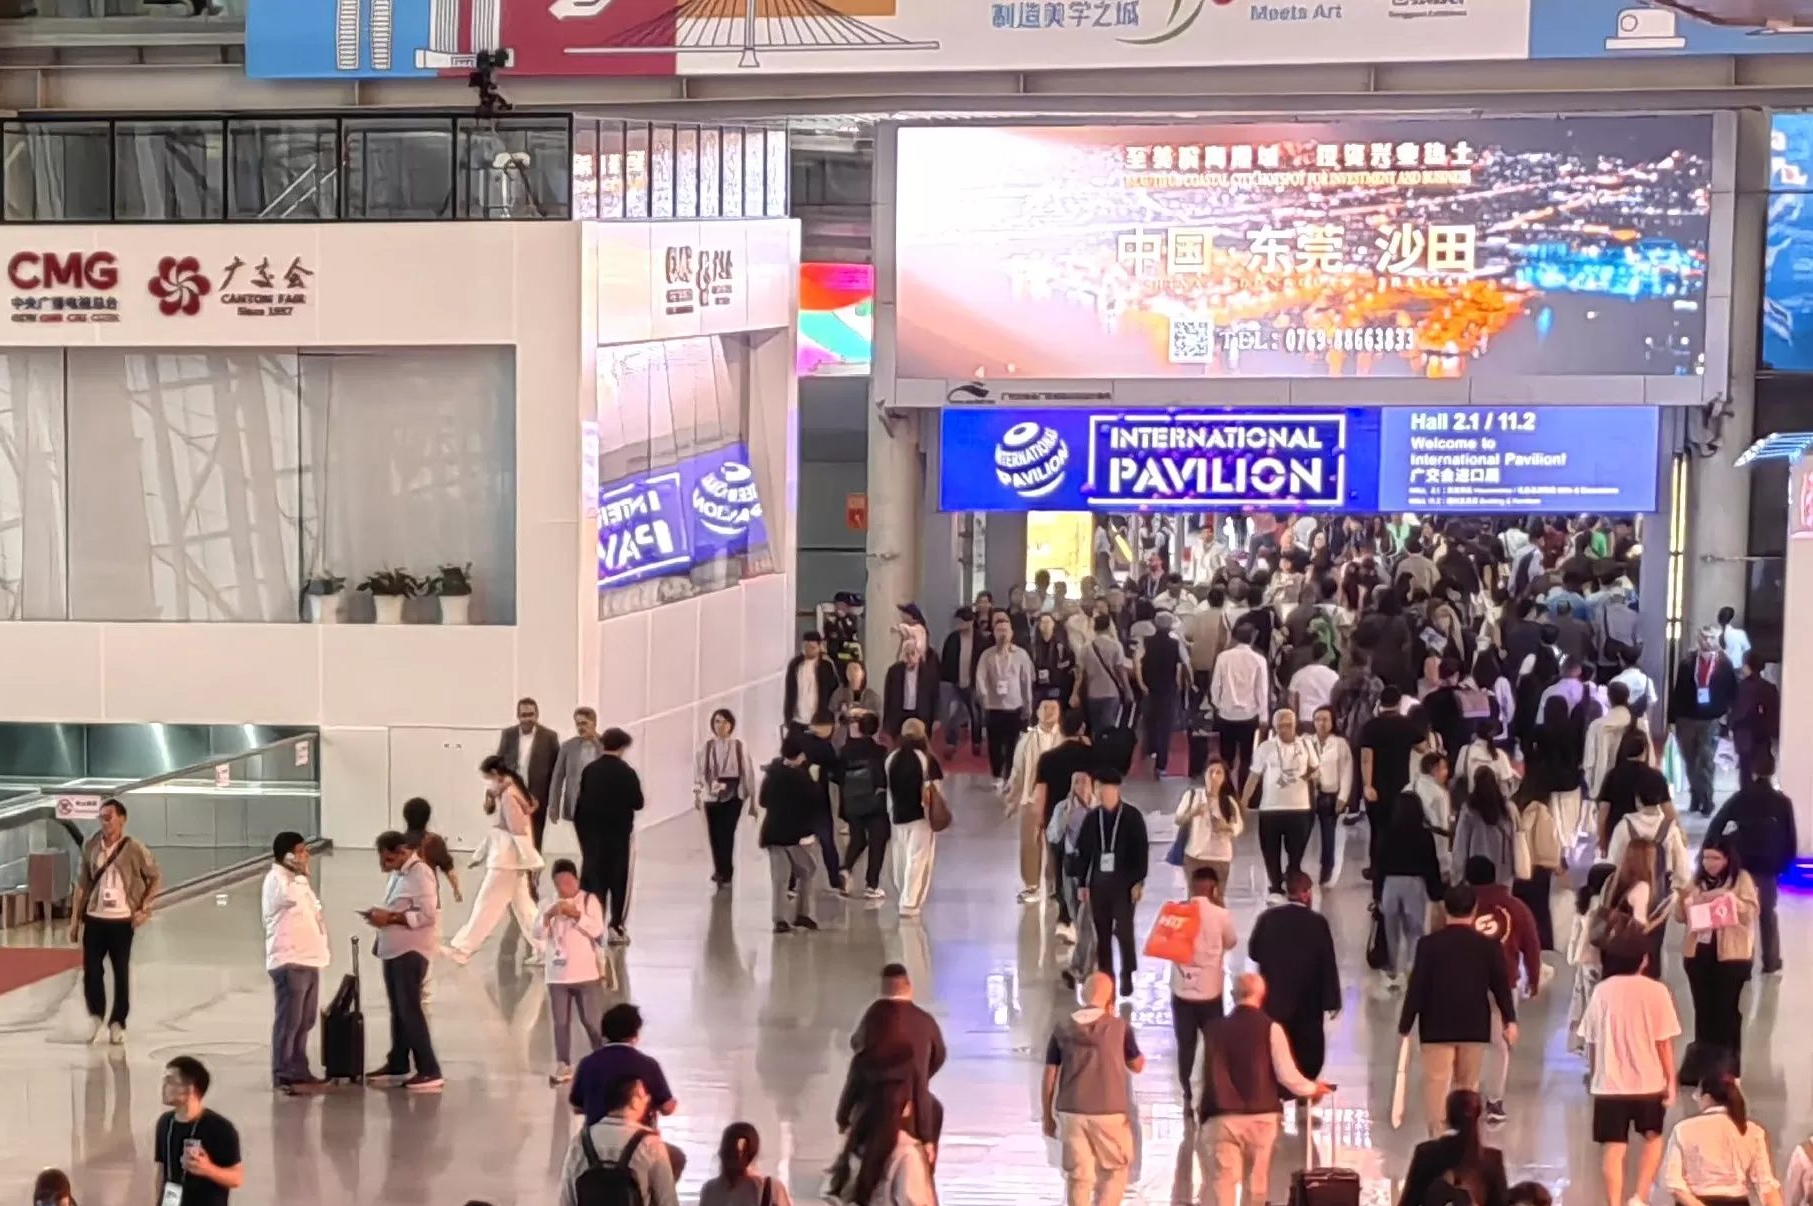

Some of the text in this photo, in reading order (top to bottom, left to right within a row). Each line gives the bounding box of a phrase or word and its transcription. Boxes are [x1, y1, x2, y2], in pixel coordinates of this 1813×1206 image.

[1312, 5, 1343, 19] Art
[8, 251, 119, 290] CMG
[218, 256, 315, 291] 广交会
[1410, 413, 1536, 431] Hall 2.1 / 11.2
[1110, 426, 1322, 448] INTERNATIONAL
[1411, 437, 1496, 450] Welcome to
[1410, 453, 1500, 466] International
[1109, 457, 1322, 493] PAVILION
